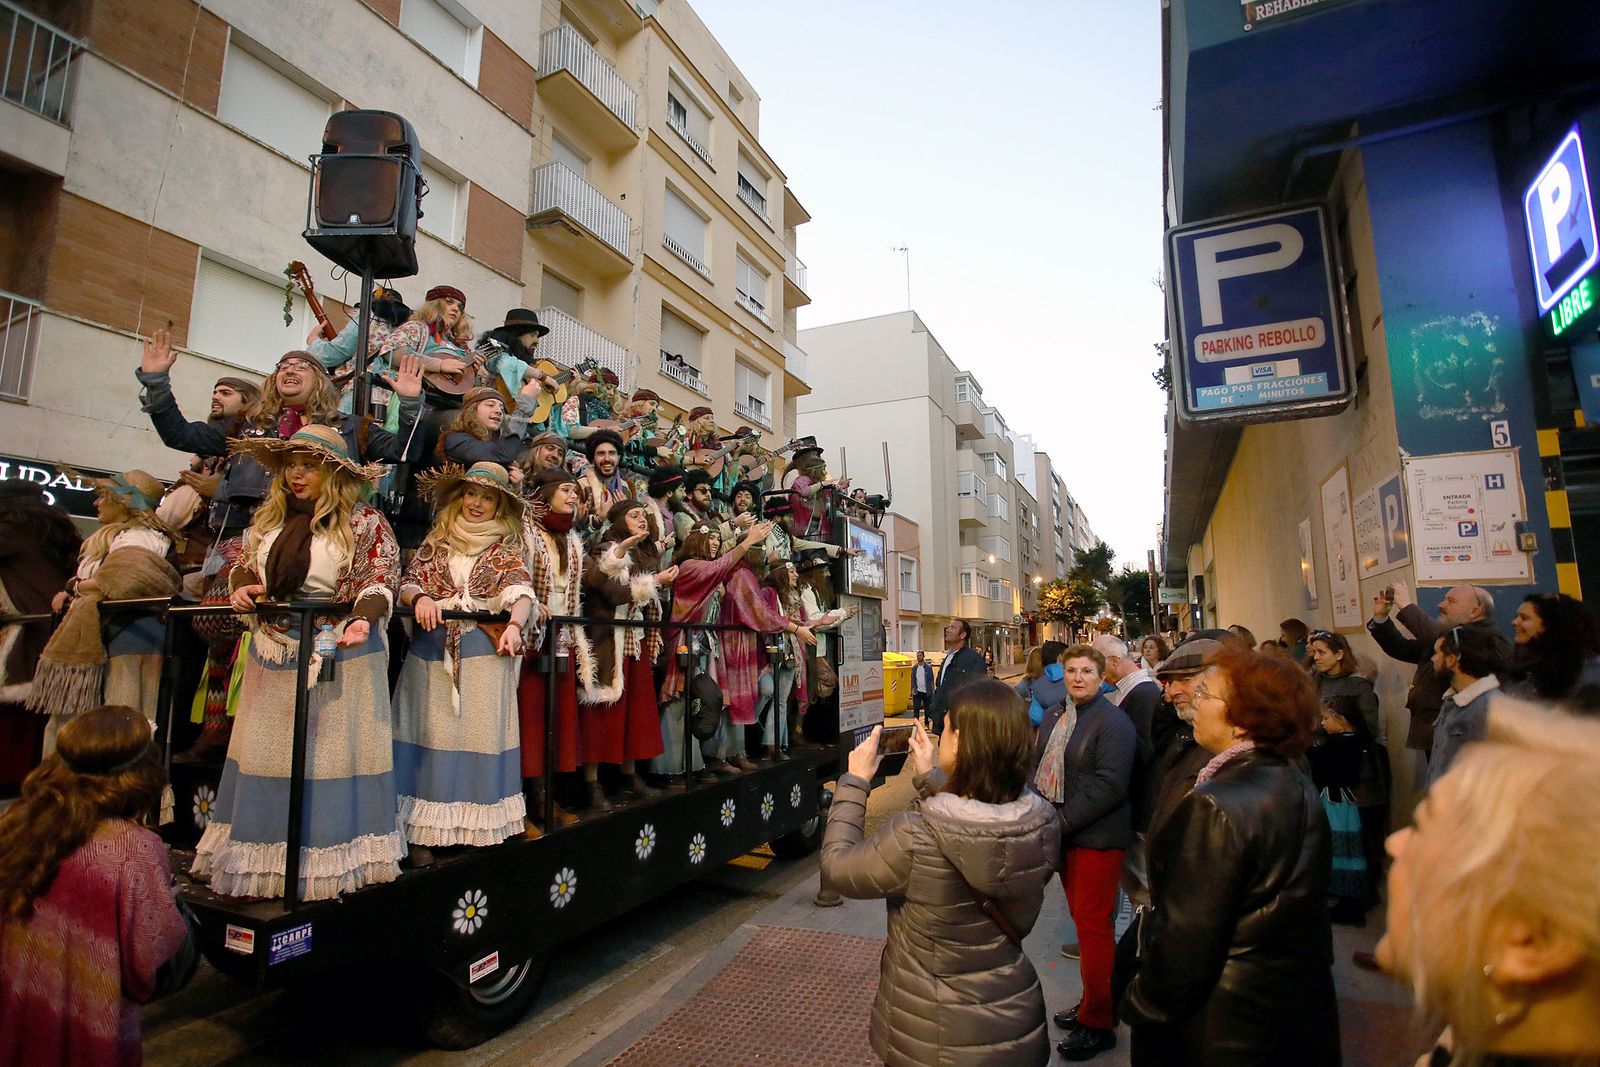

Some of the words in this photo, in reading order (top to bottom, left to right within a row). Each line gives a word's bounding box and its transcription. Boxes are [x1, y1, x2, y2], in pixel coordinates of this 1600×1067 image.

[1537, 161, 1572, 264] P
[1193, 223, 1304, 328] P
[1551, 279, 1591, 335] LIBRE
[1201, 334, 1254, 356] PARKING
[1258, 325, 1316, 348] REBOLLO
[1254, 366, 1273, 374] VISA
[1201, 387, 1229, 397] PAGO
[1232, 384, 1253, 393] POR
[1257, 375, 1323, 390] FRACCIONES
[1220, 395, 1234, 404] DE
[1258, 387, 1305, 400] MINUTOS
[1494, 423, 1508, 446] 5
[1488, 475, 1502, 487] H
[1385, 494, 1399, 548] P
[1461, 523, 1472, 536] P
